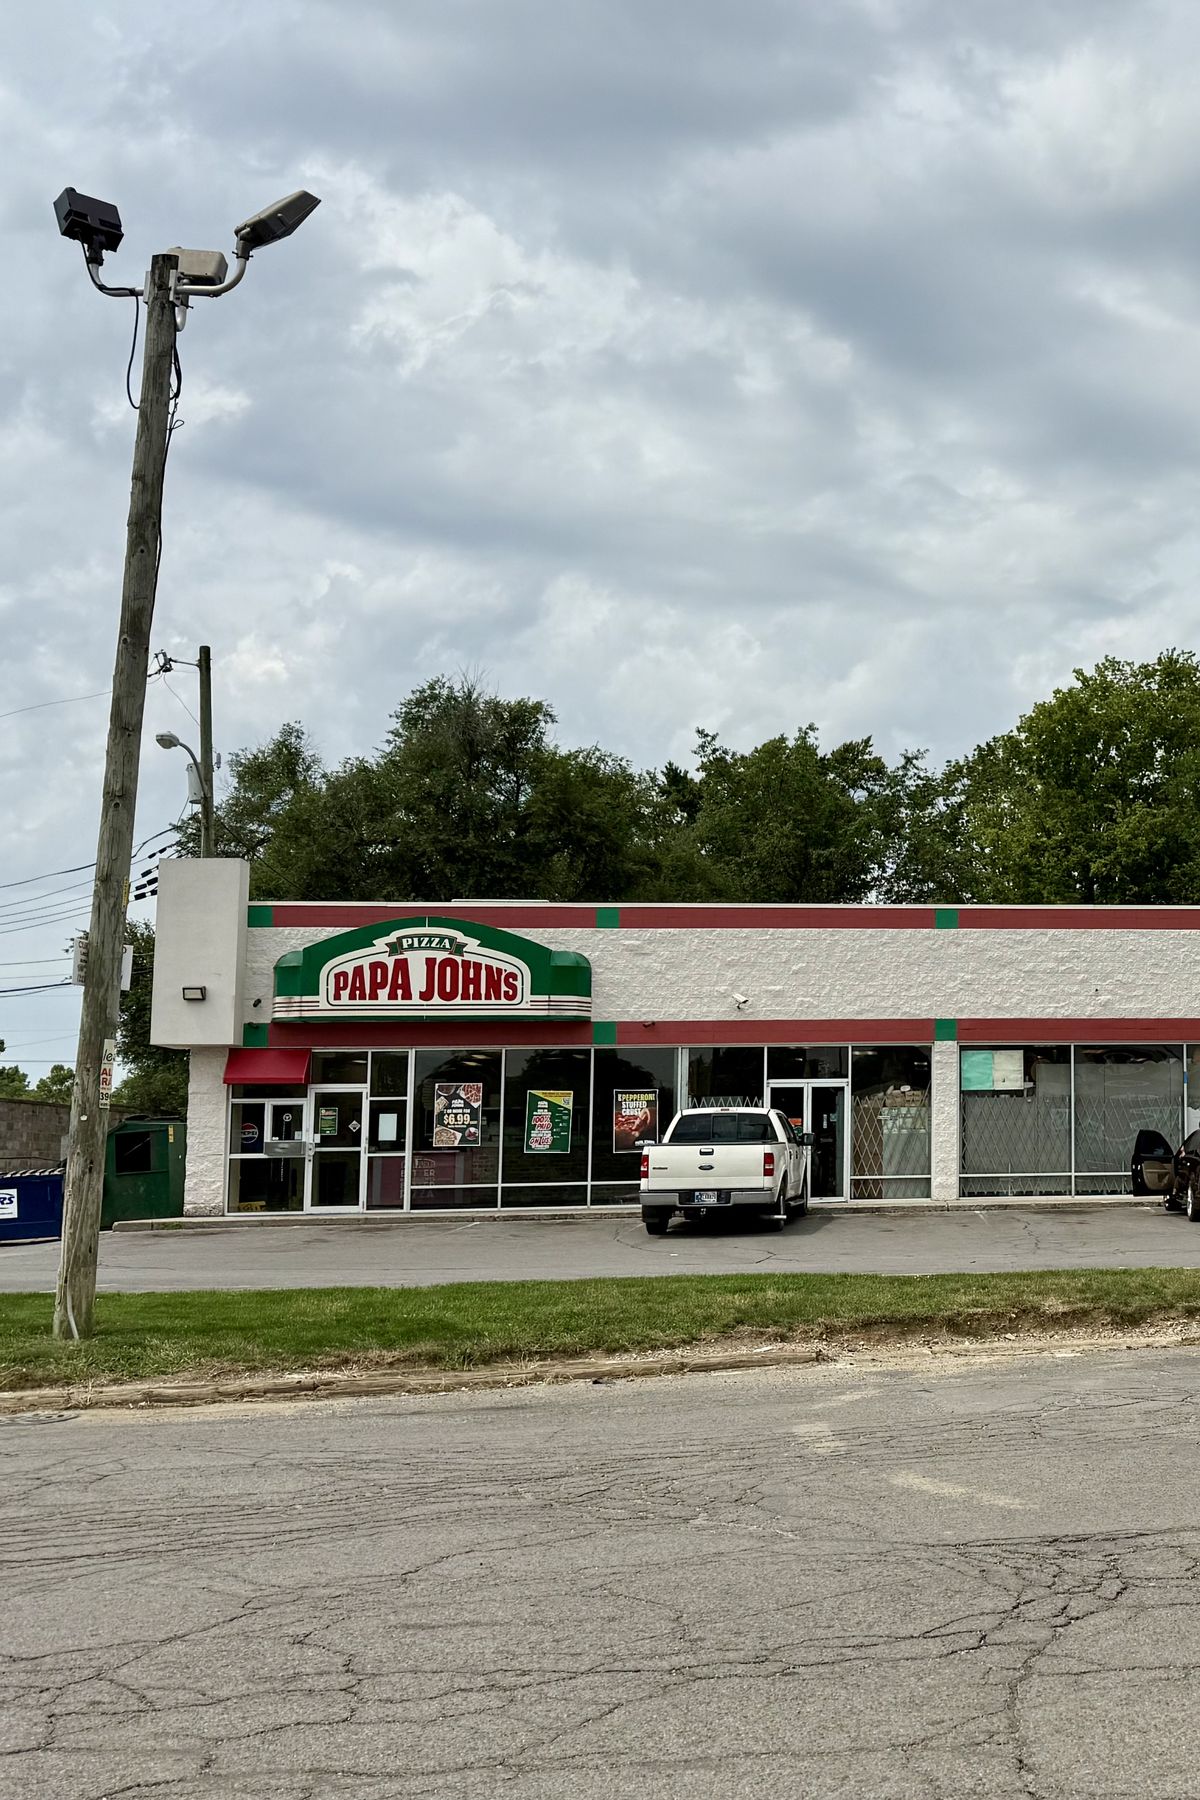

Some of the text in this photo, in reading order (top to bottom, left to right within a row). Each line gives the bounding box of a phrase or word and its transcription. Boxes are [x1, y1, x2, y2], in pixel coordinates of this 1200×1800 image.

[402, 937, 451, 950] PIZZA
[333, 957, 413, 1001] PAPA
[444, 1114, 470, 1124] $6.99
